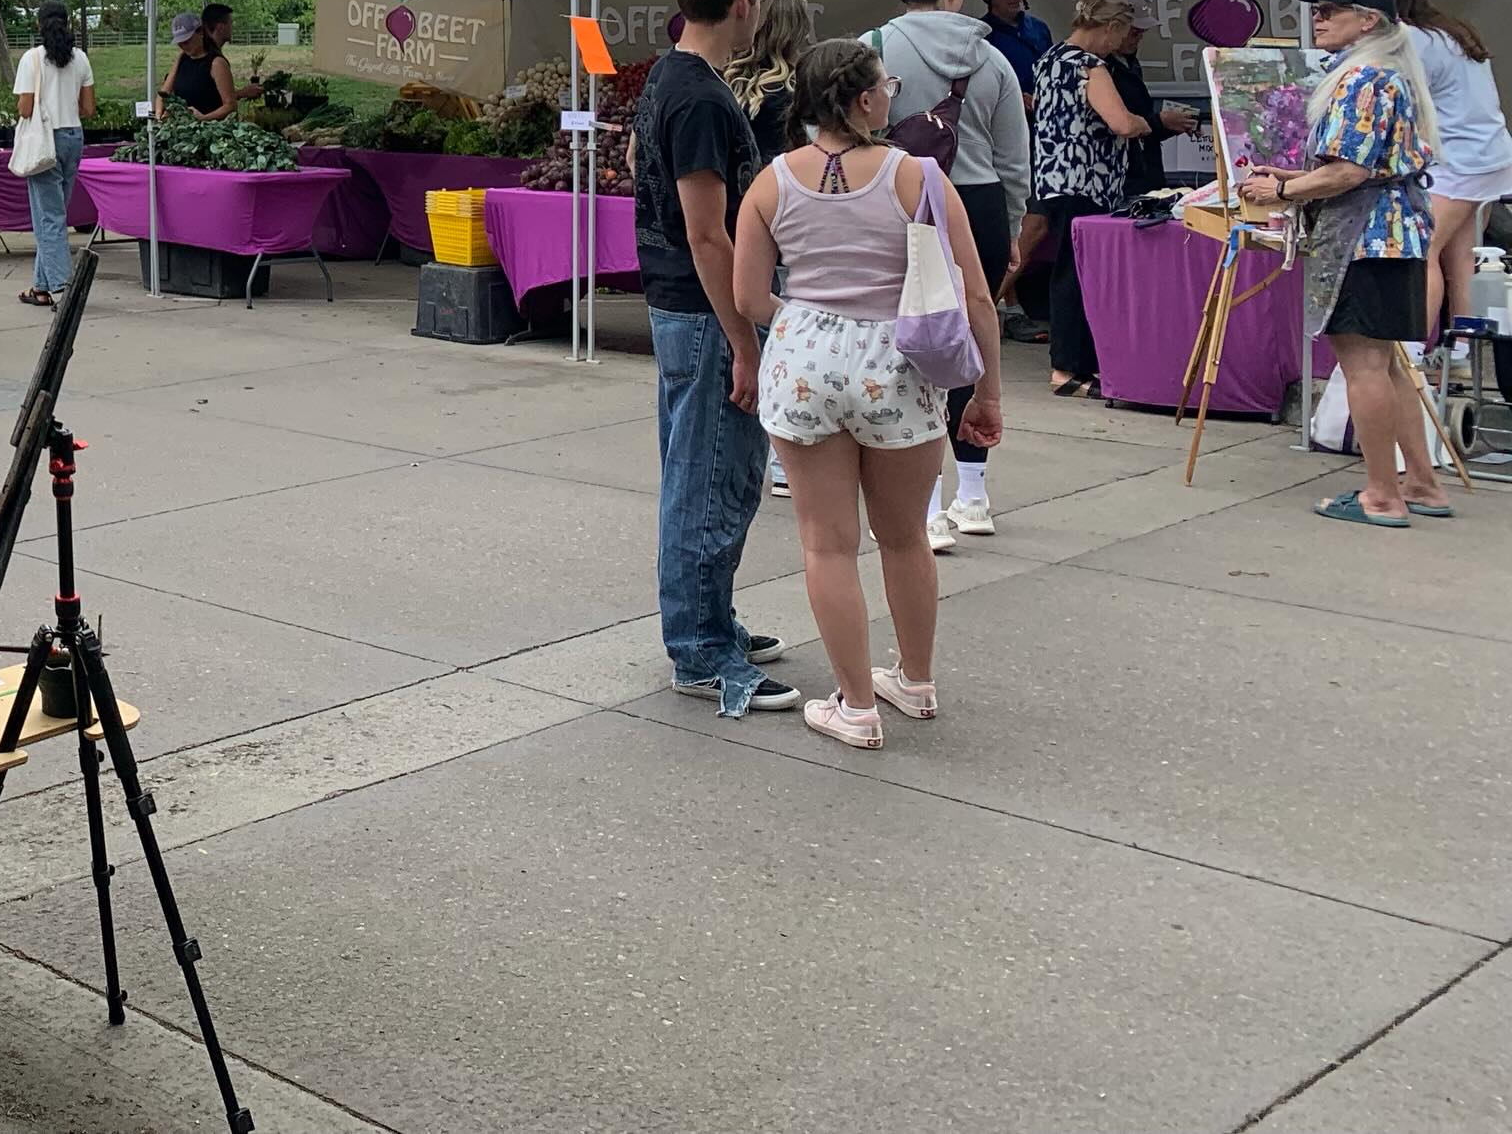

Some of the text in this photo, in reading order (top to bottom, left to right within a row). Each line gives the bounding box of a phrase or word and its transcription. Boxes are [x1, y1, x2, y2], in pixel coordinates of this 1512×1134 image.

[417, 11, 486, 45] BEET
[600, 5, 669, 45] OFF
[376, 33, 435, 67] FARM
